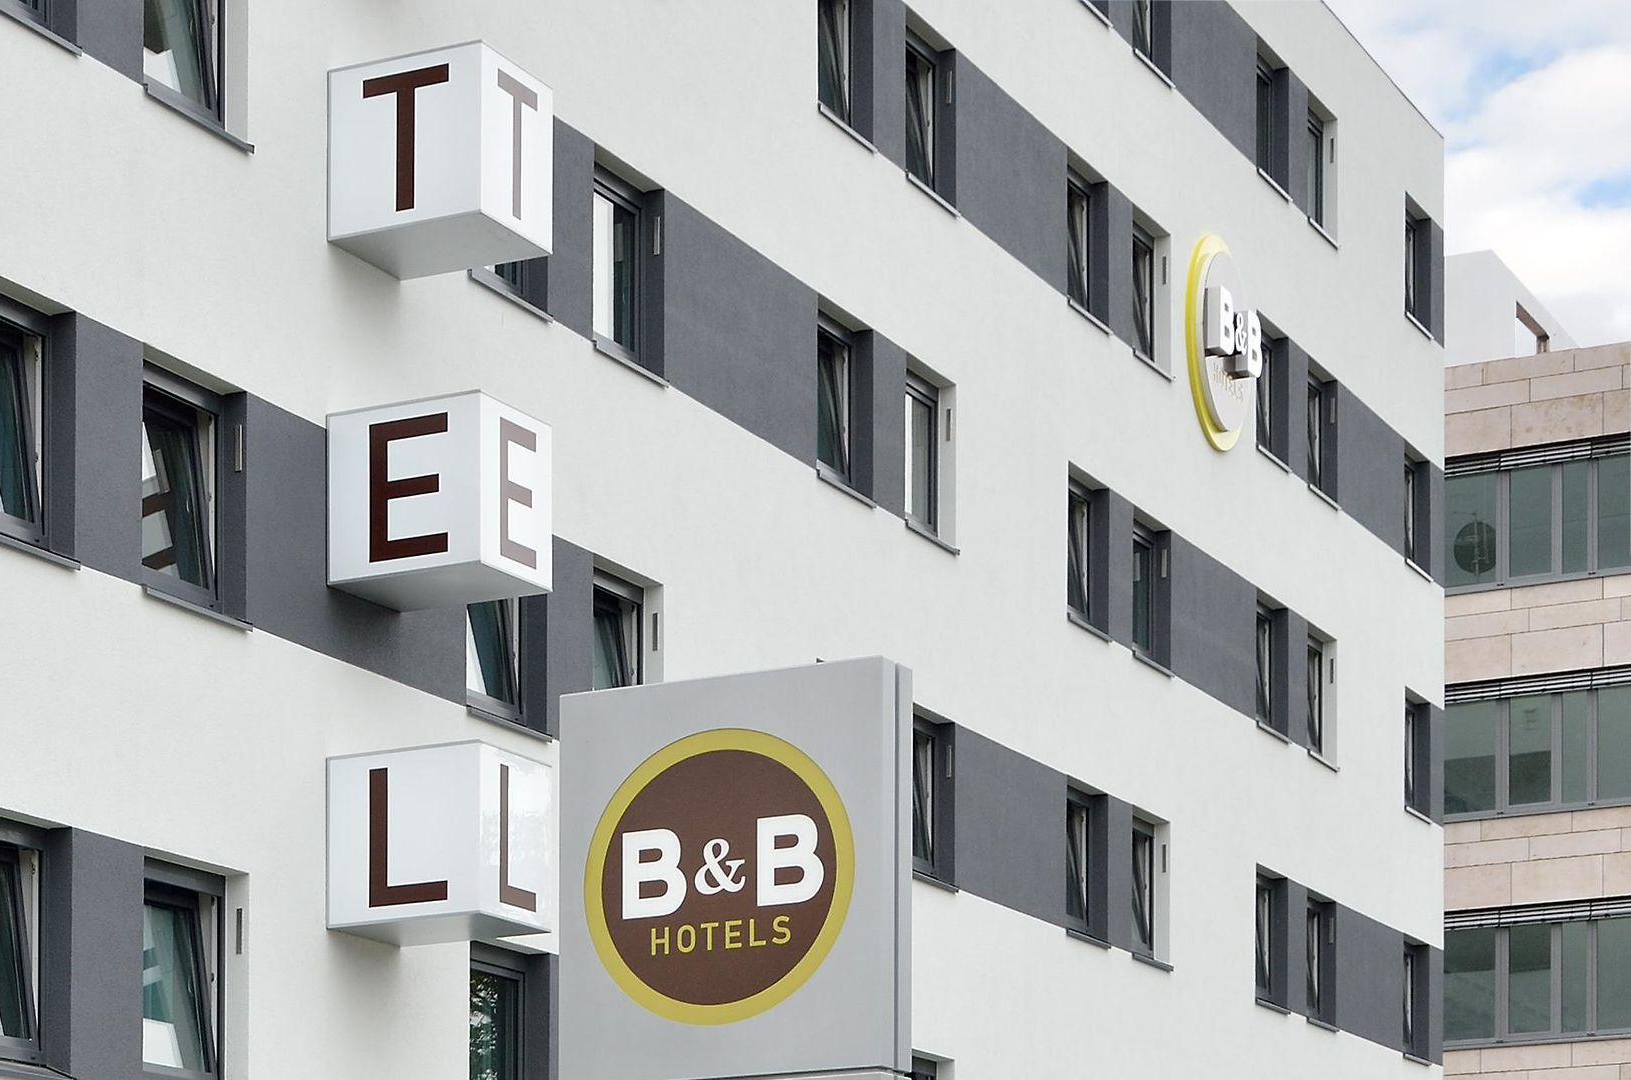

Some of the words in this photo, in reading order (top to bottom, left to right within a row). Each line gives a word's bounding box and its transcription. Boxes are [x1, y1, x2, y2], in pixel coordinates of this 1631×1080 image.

[1208, 284, 1262, 378] B&B
[622, 814, 825, 920] B&B
[651, 915, 791, 956] HOTELS
